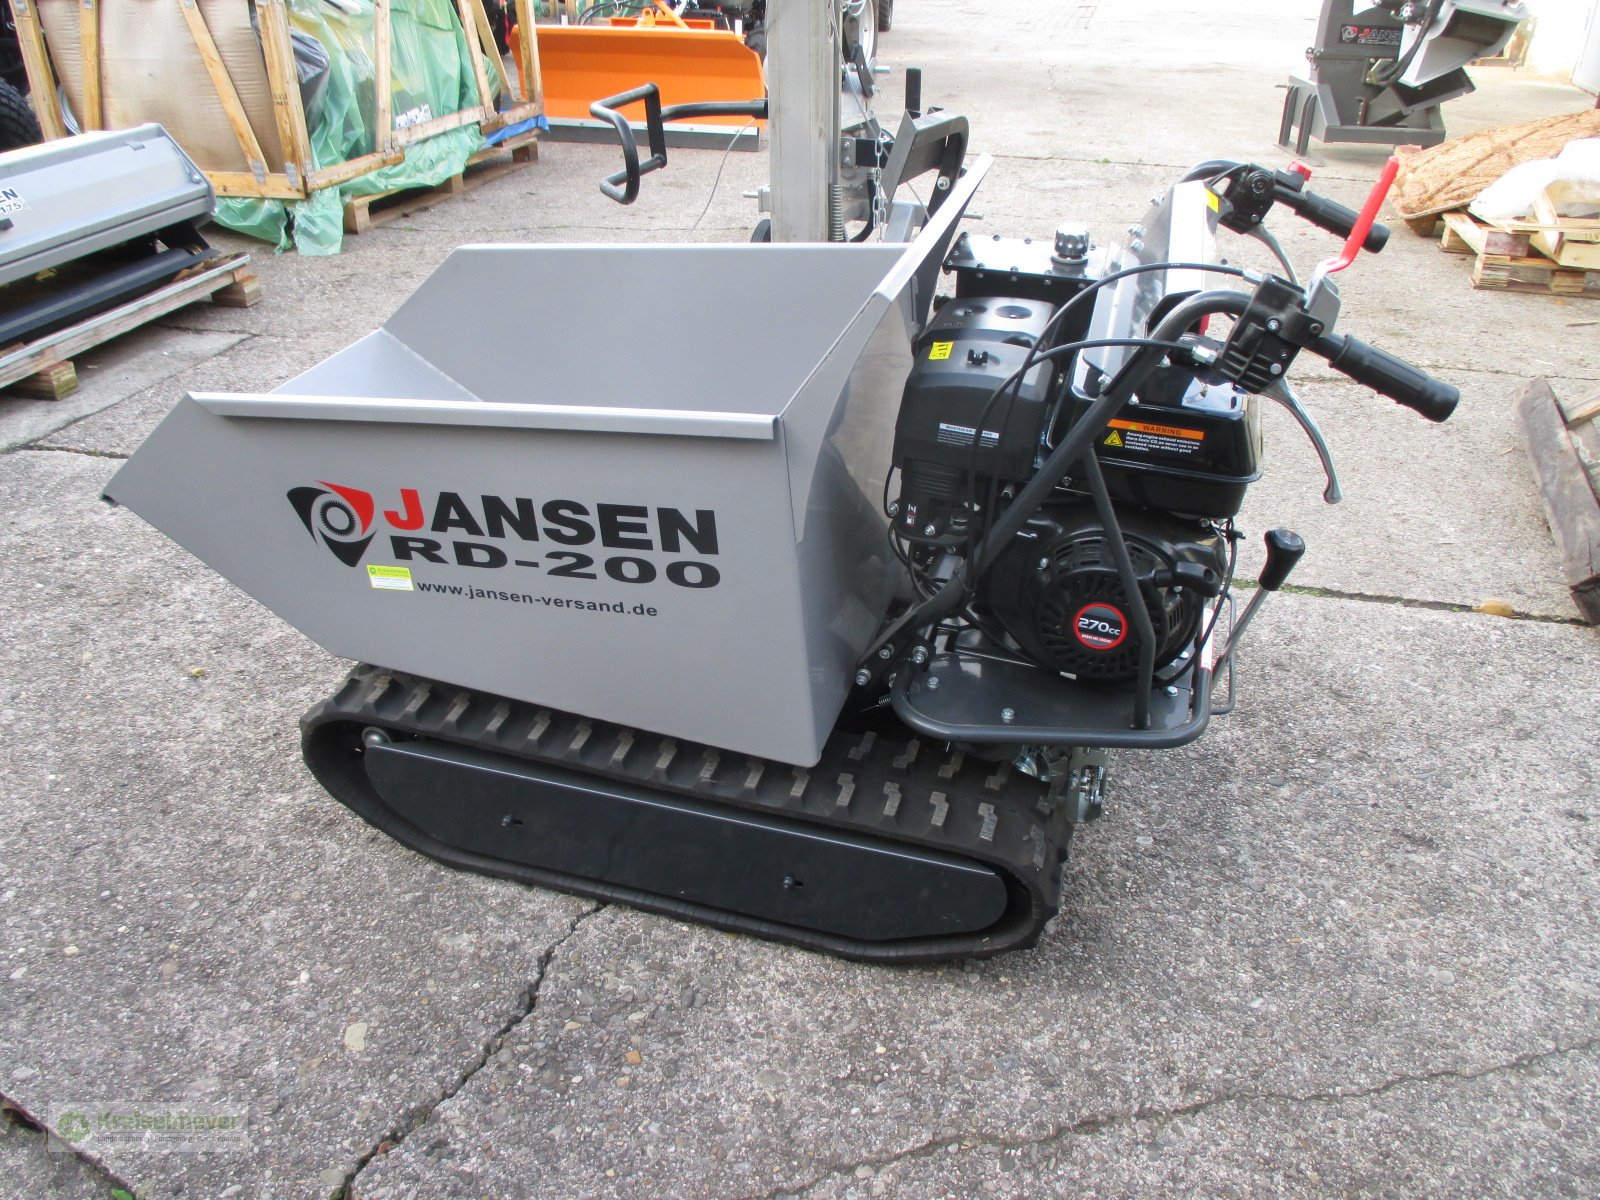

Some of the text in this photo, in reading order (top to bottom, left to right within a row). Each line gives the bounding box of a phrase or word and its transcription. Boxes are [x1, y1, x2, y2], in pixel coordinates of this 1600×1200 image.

[1142, 424, 1181, 435] WARNING
[383, 488, 720, 556] JANSEN
[390, 536, 721, 589] RD-200
[417, 581, 658, 617] www.jansen-versand.de
[1078, 618, 1120, 636] 270cc
